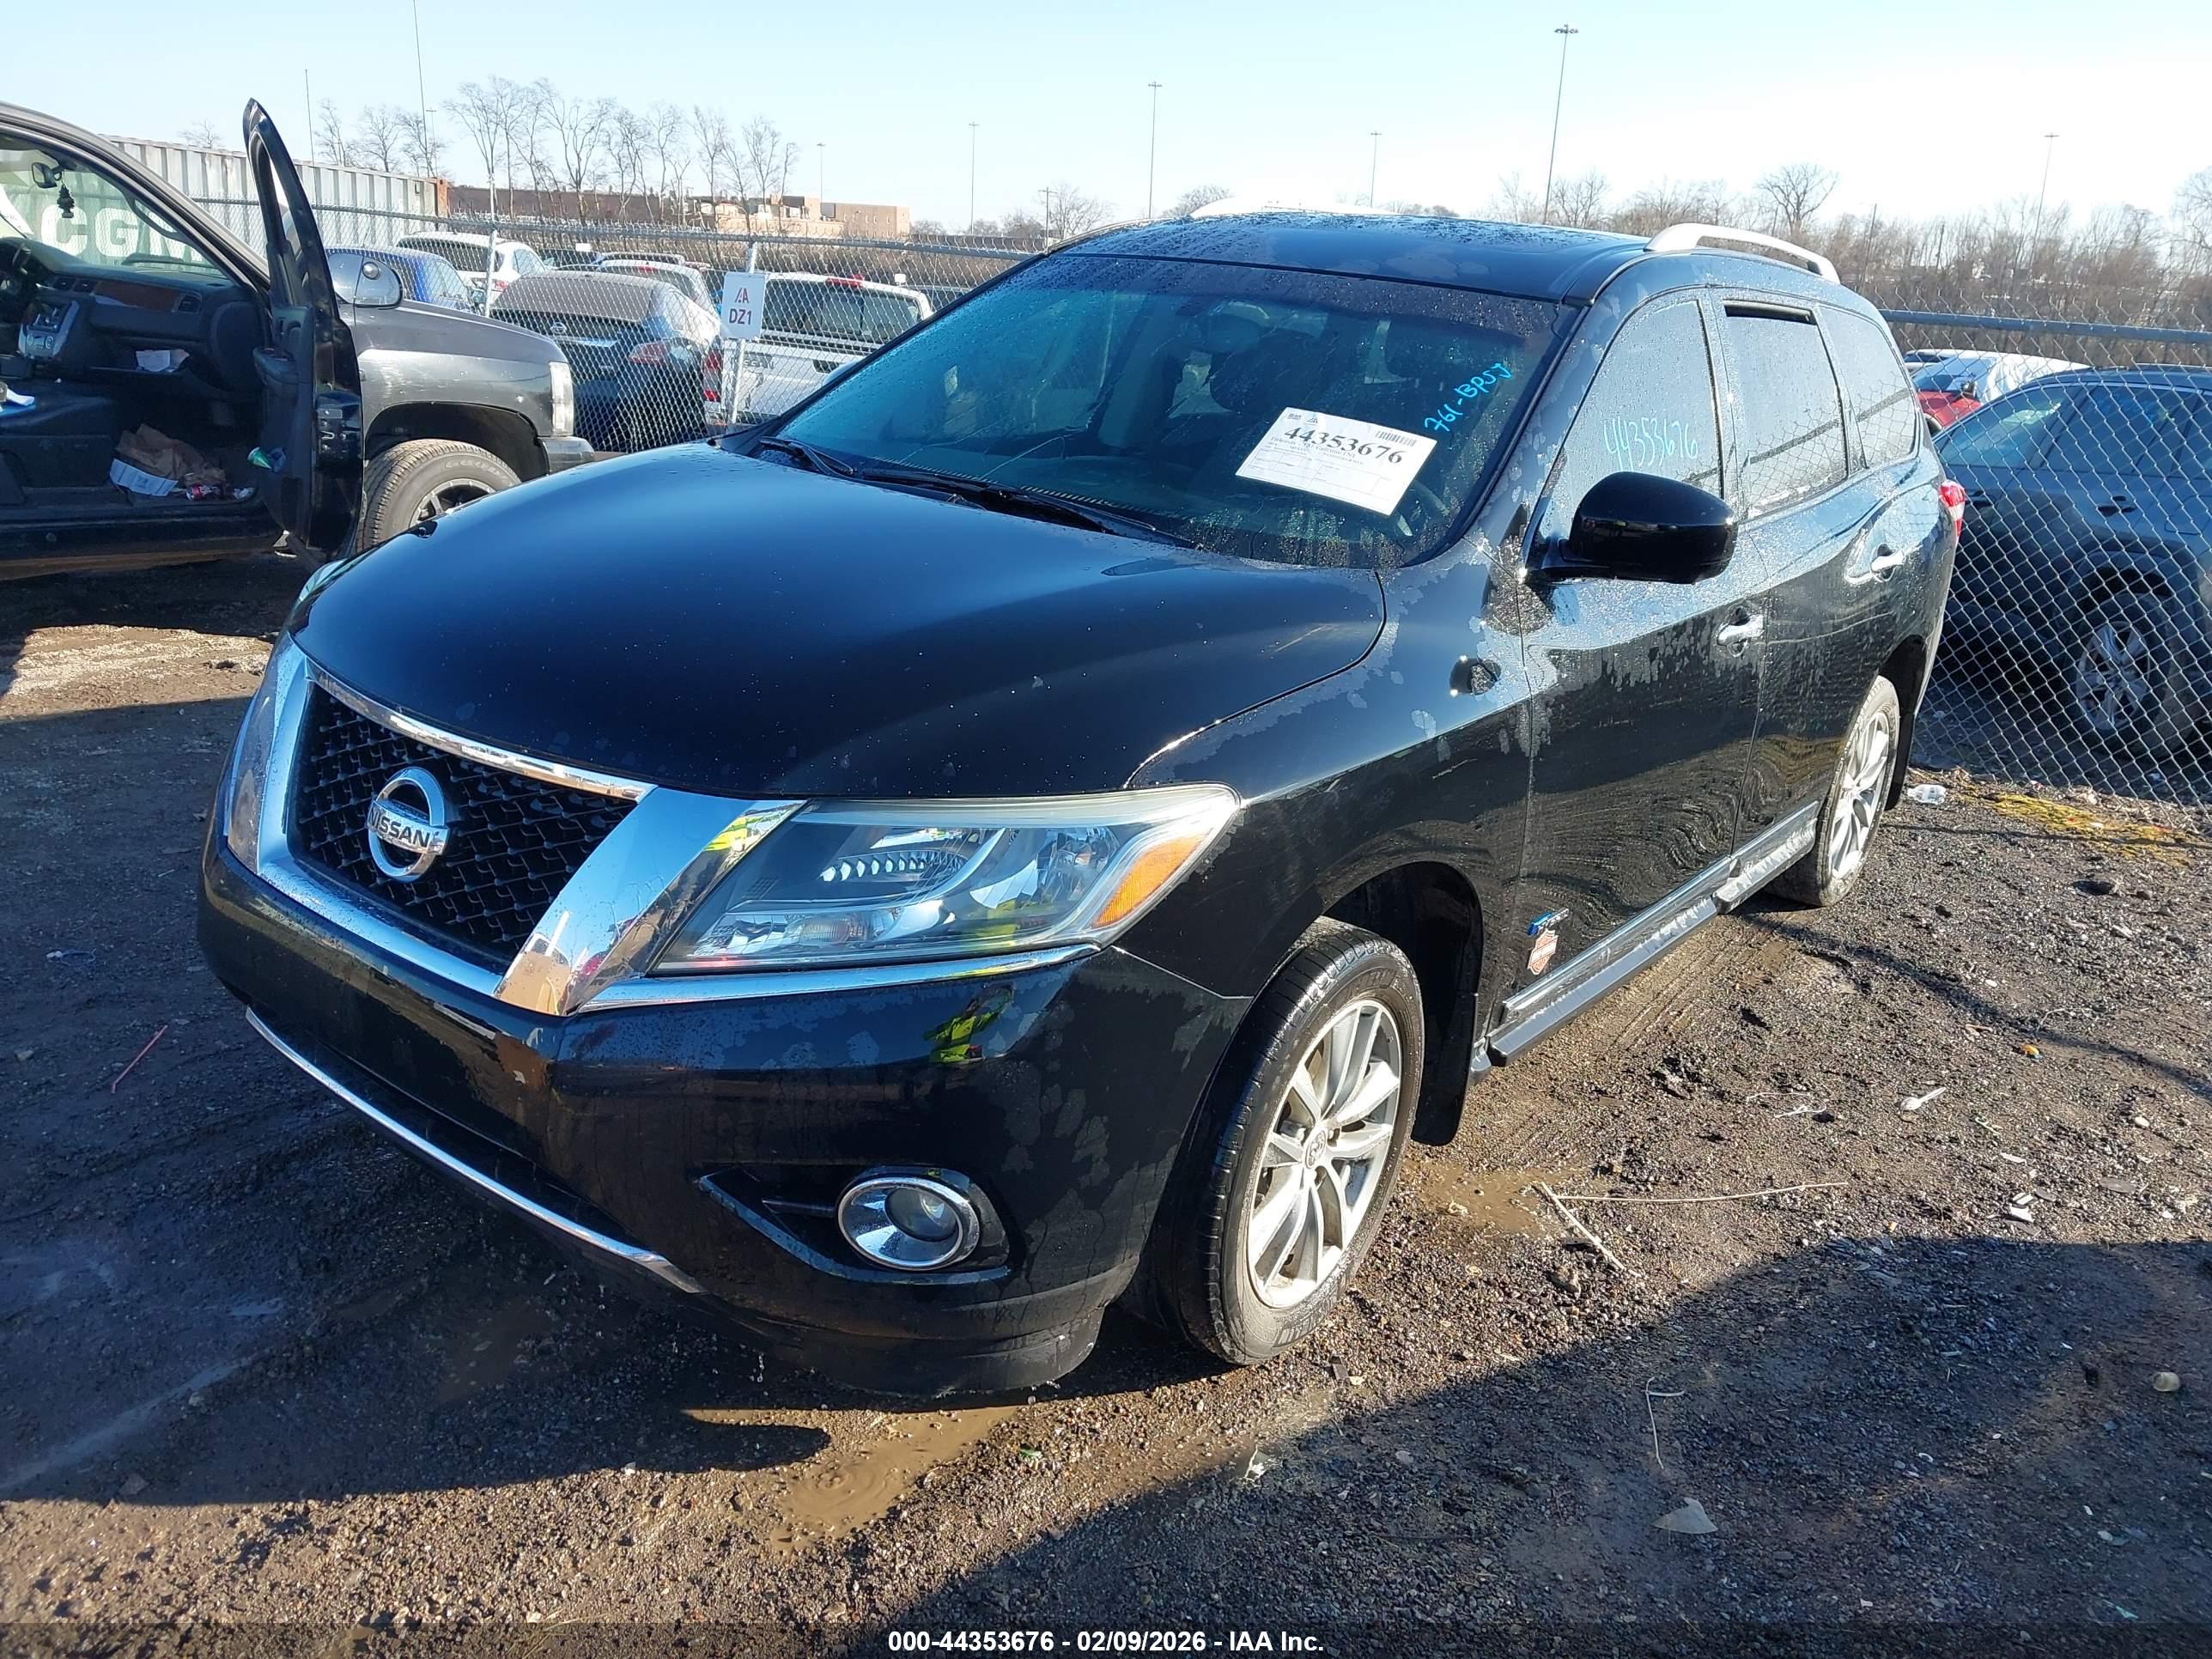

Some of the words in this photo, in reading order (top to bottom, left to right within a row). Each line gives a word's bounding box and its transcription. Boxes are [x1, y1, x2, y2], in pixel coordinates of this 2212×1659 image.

[729, 308, 752, 325] DZ1
[1285, 427, 1407, 464] 44353676
[1603, 416, 1698, 471] 44353676
[369, 805, 429, 848] NISSAN
